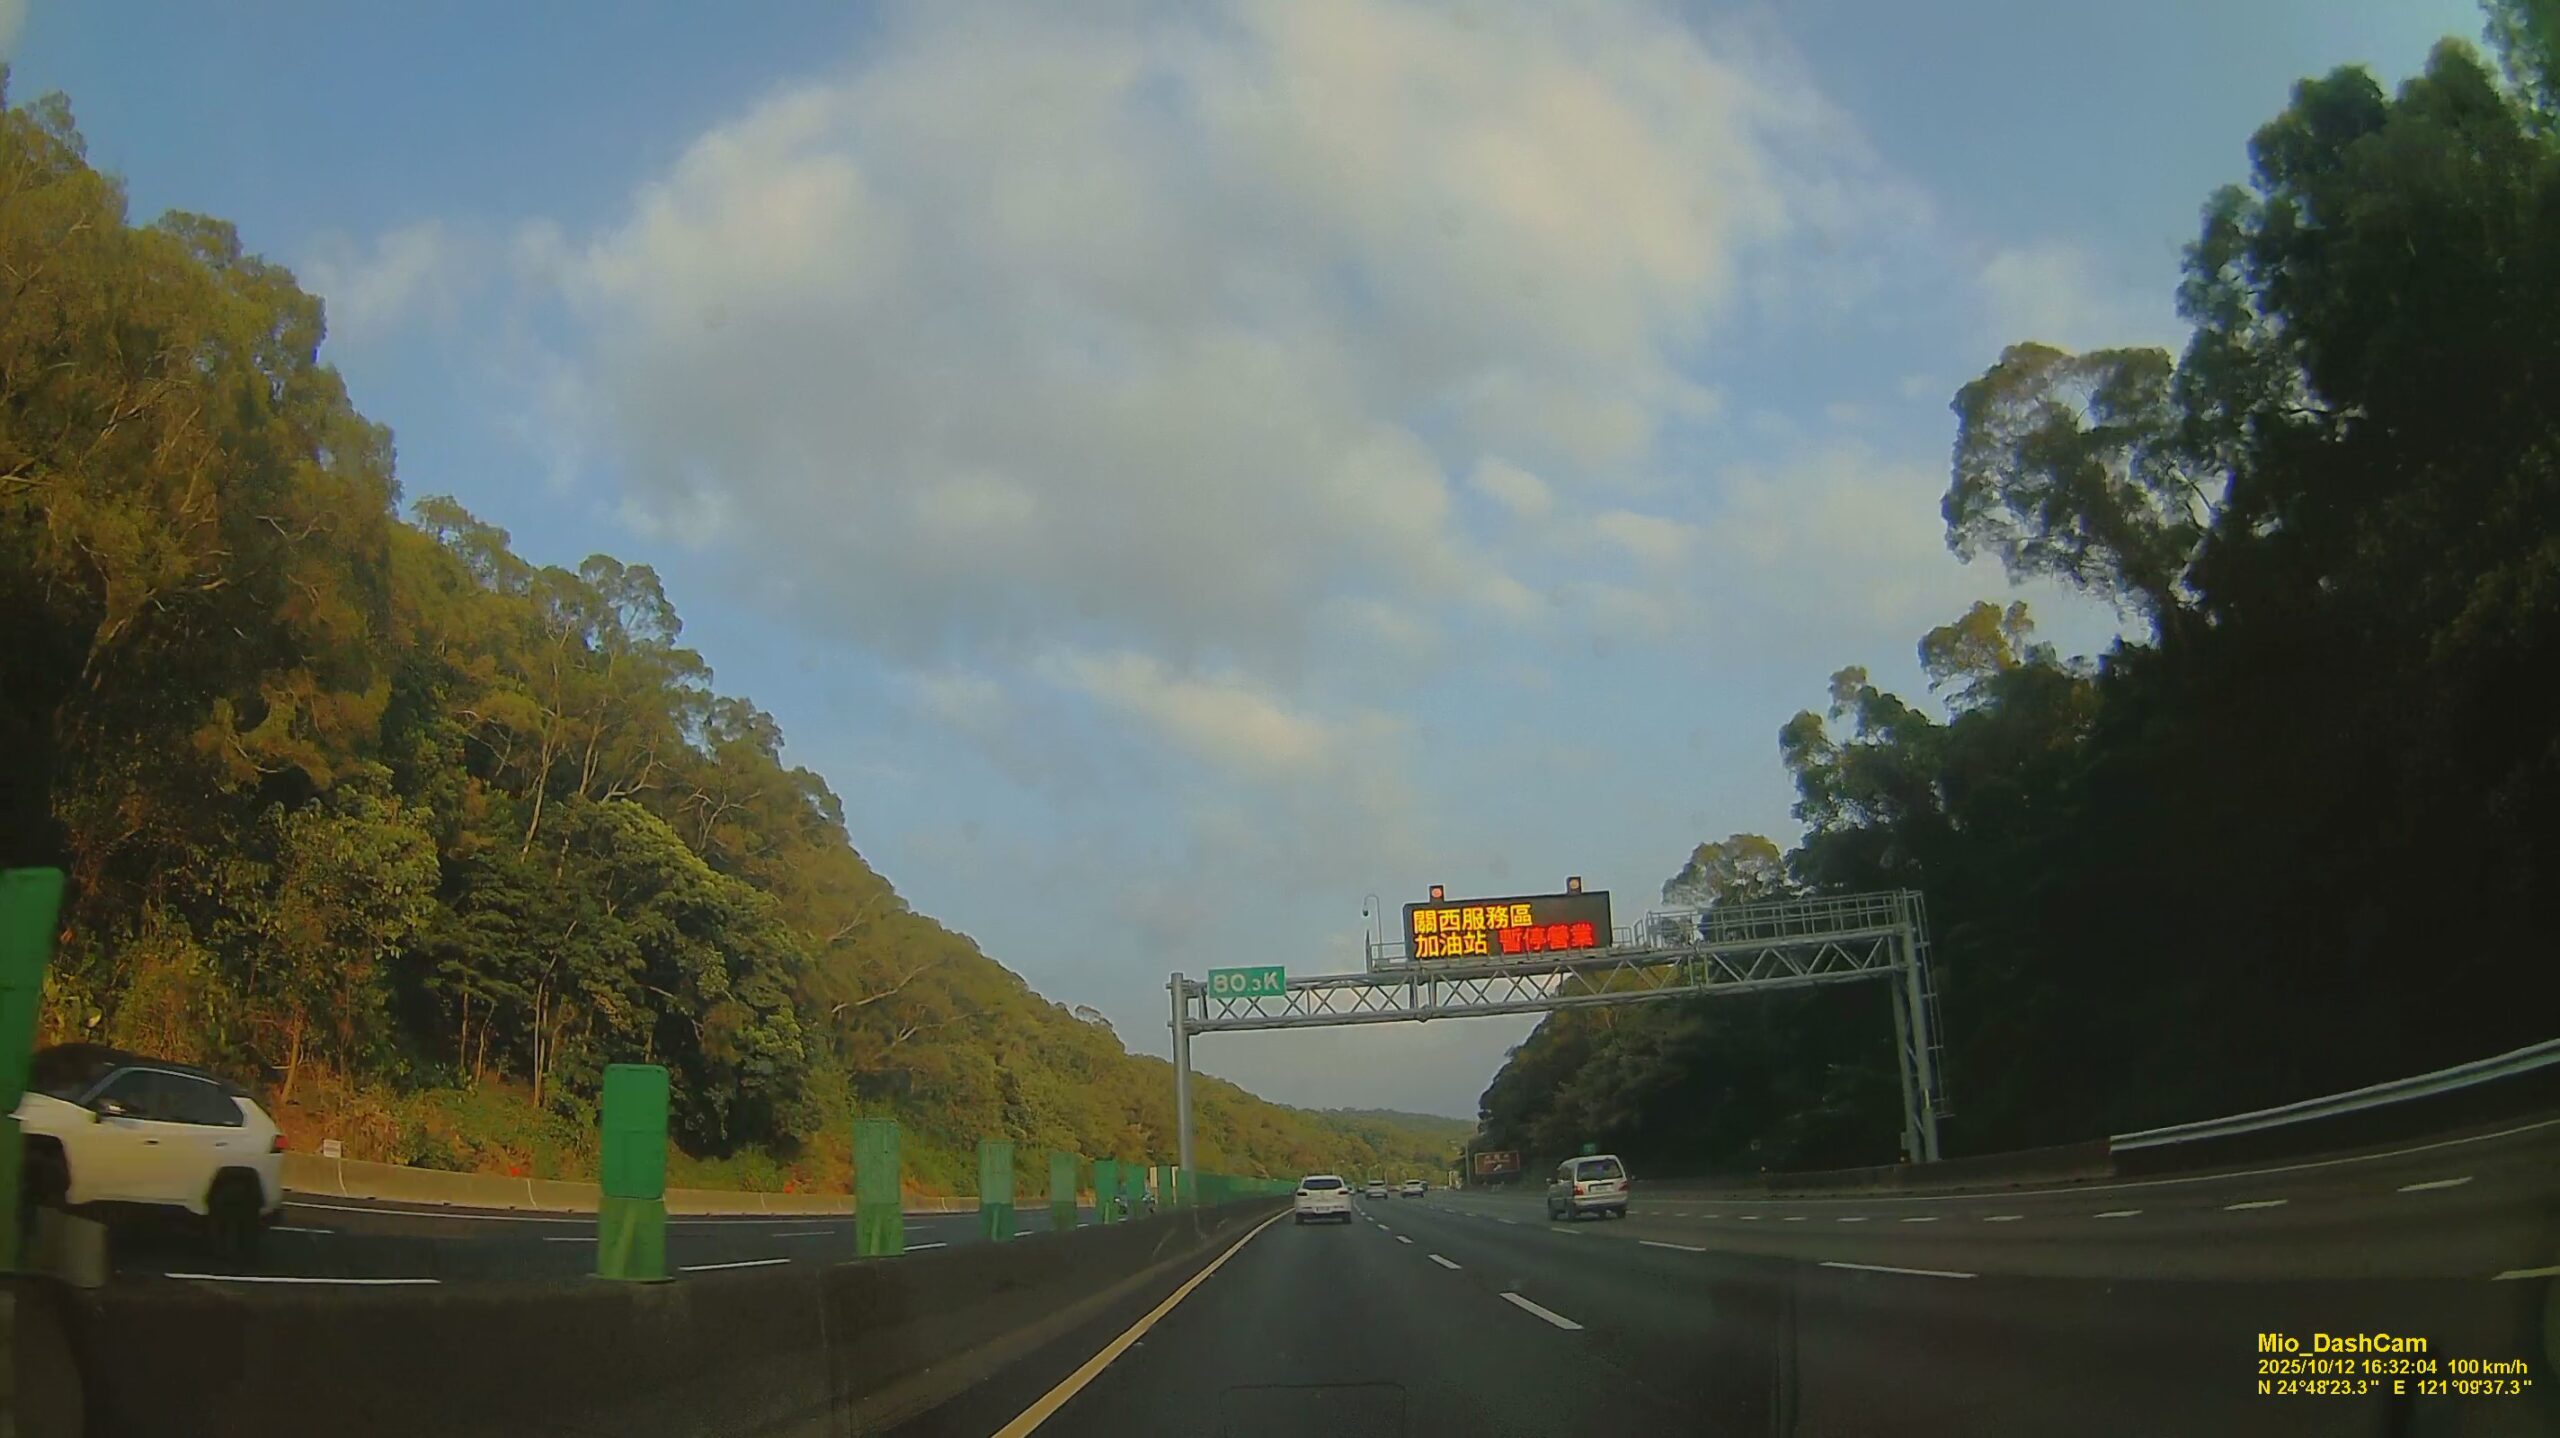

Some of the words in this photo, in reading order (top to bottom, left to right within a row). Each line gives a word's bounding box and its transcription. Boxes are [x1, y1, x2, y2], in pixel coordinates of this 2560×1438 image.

[1413, 904, 1532, 934] 關西服務區
[1415, 930, 1488, 958] 加油站
[1213, 971, 1280, 993] 80.3K
